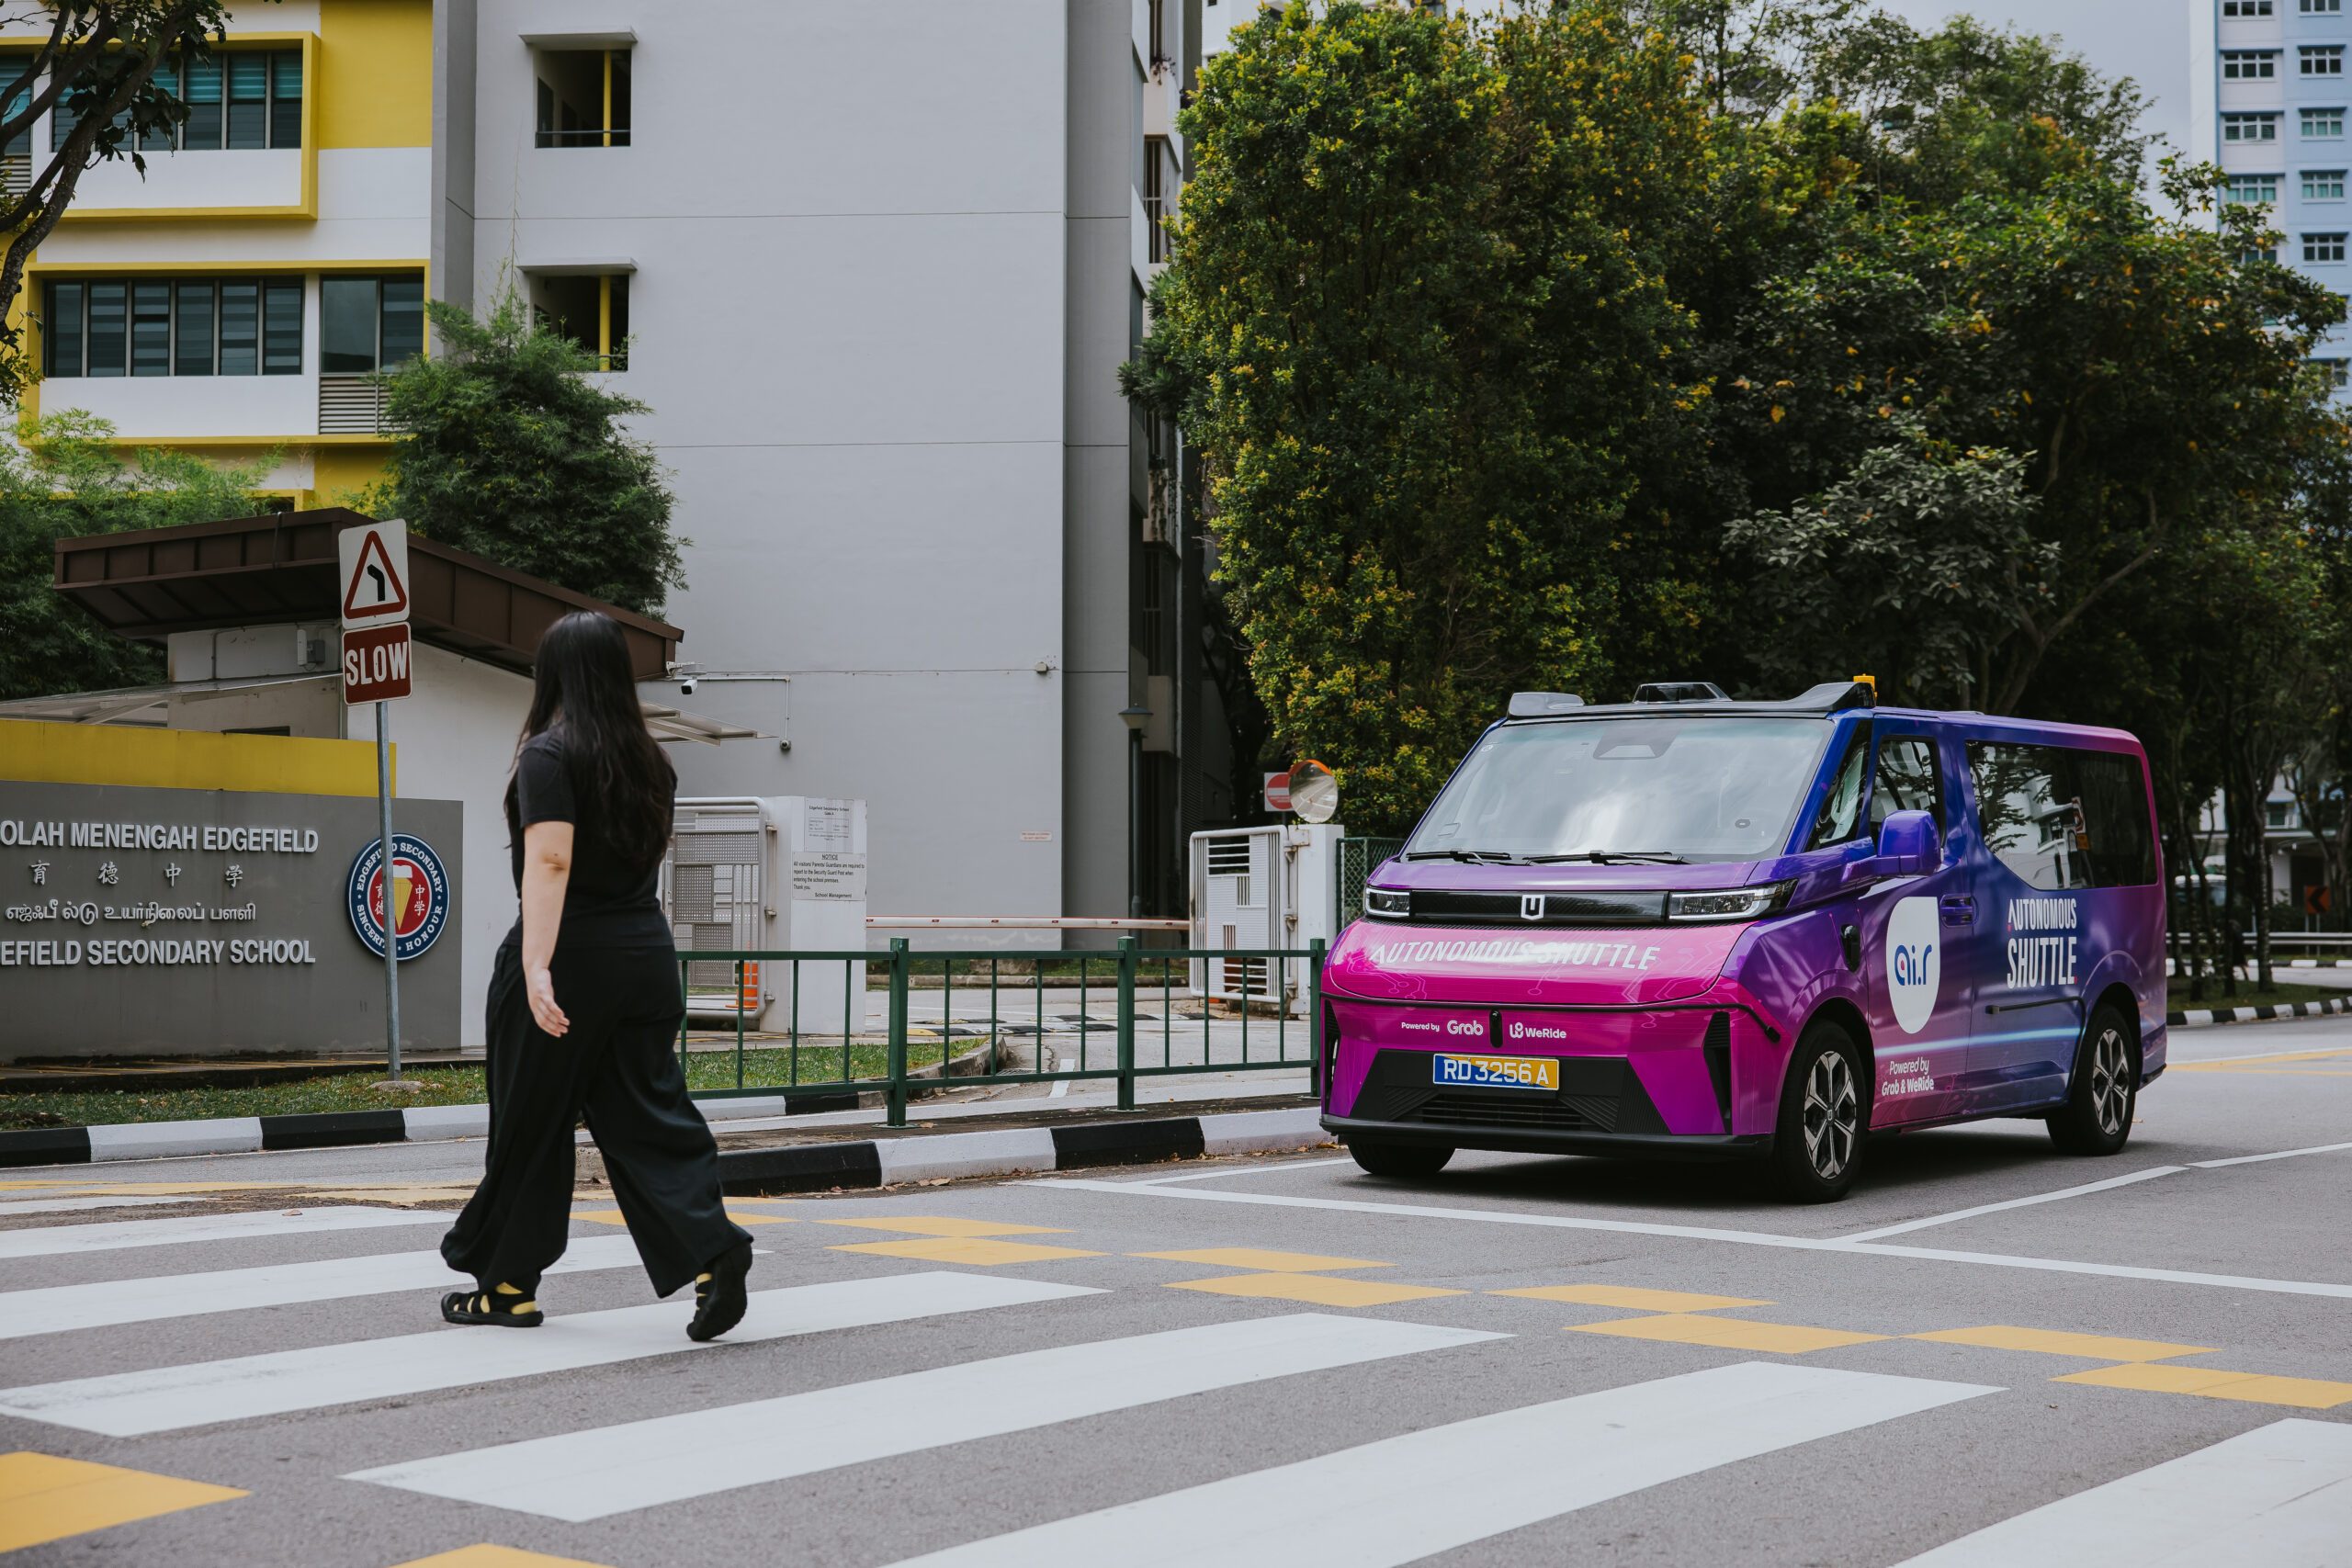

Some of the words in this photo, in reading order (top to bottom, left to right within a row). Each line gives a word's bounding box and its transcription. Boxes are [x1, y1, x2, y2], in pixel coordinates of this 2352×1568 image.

[345, 641, 408, 686] SLOW
[70, 822, 197, 850] MENENGAH
[203, 827, 319, 852] EDGEFIELD
[400, 842, 443, 892] SECONDARY
[2007, 897, 2076, 931] AUTONOMOUS
[406, 906, 443, 951] HONOUR
[87, 940, 225, 964] SECONDARY
[231, 939, 316, 964] SCHOOL
[1370, 941, 1534, 964] AUTONOMOUS
[1536, 941, 1660, 970] SHUTTLE
[1401, 1021, 1430, 1030] Powered
[1430, 1022, 1440, 1032] by
[1447, 1020, 1484, 1035] Grab
[1525, 1028, 1567, 1039] WeRide
[1443, 1059, 1471, 1080] RD
[1475, 1061, 1532, 1084] 3256
[1535, 1064, 1549, 1085] A
[1889, 1056, 1919, 1076] Powered
[1920, 1056, 1929, 1075] by
[1882, 1079, 1899, 1096] Grab
[1900, 1078, 1905, 1094] &
[1906, 1076, 1934, 1092] WeRide
